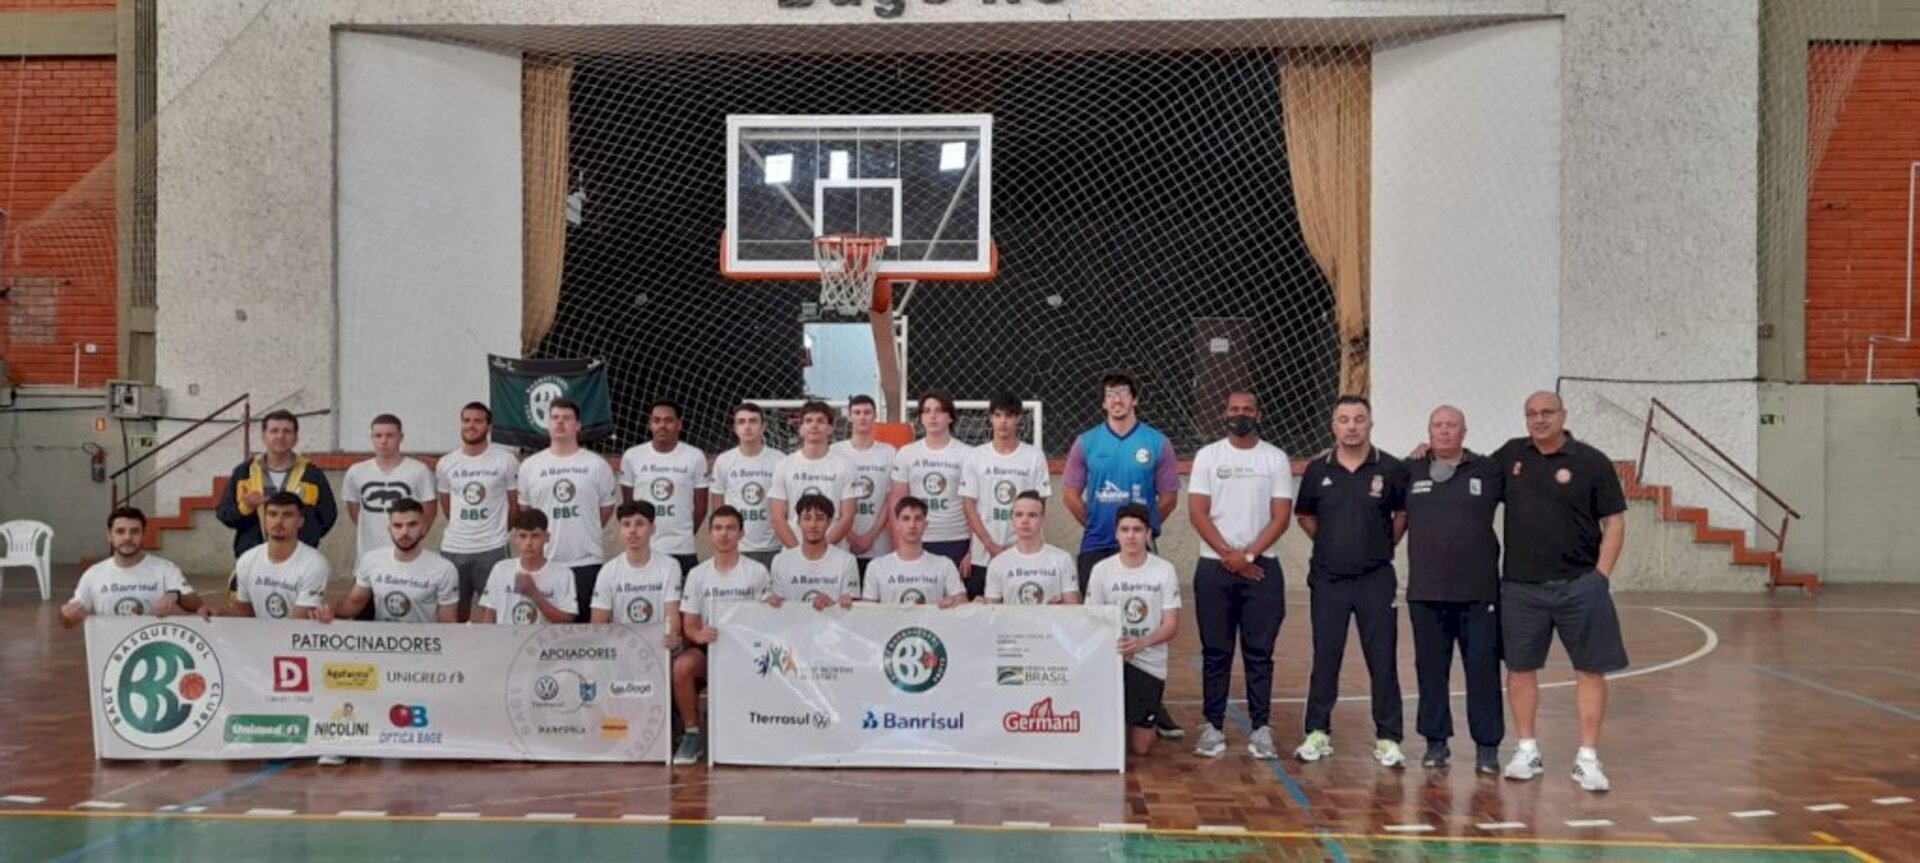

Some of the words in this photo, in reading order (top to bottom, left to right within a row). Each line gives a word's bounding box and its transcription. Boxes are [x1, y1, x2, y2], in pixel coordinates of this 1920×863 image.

[460, 507, 489, 520] BBC
[552, 506, 580, 519] BBC
[113, 626, 211, 663] BASQUETEBOL
[292, 633, 442, 651] PATROCINADORES
[540, 648, 617, 660] APOIADORES
[387, 671, 446, 684] UNICRED
[1025, 671, 1068, 682] BRASIL
[884, 711, 964, 730] Banrisul
[1004, 711, 1079, 732] Germani
[314, 722, 369, 736] NICOLINI
